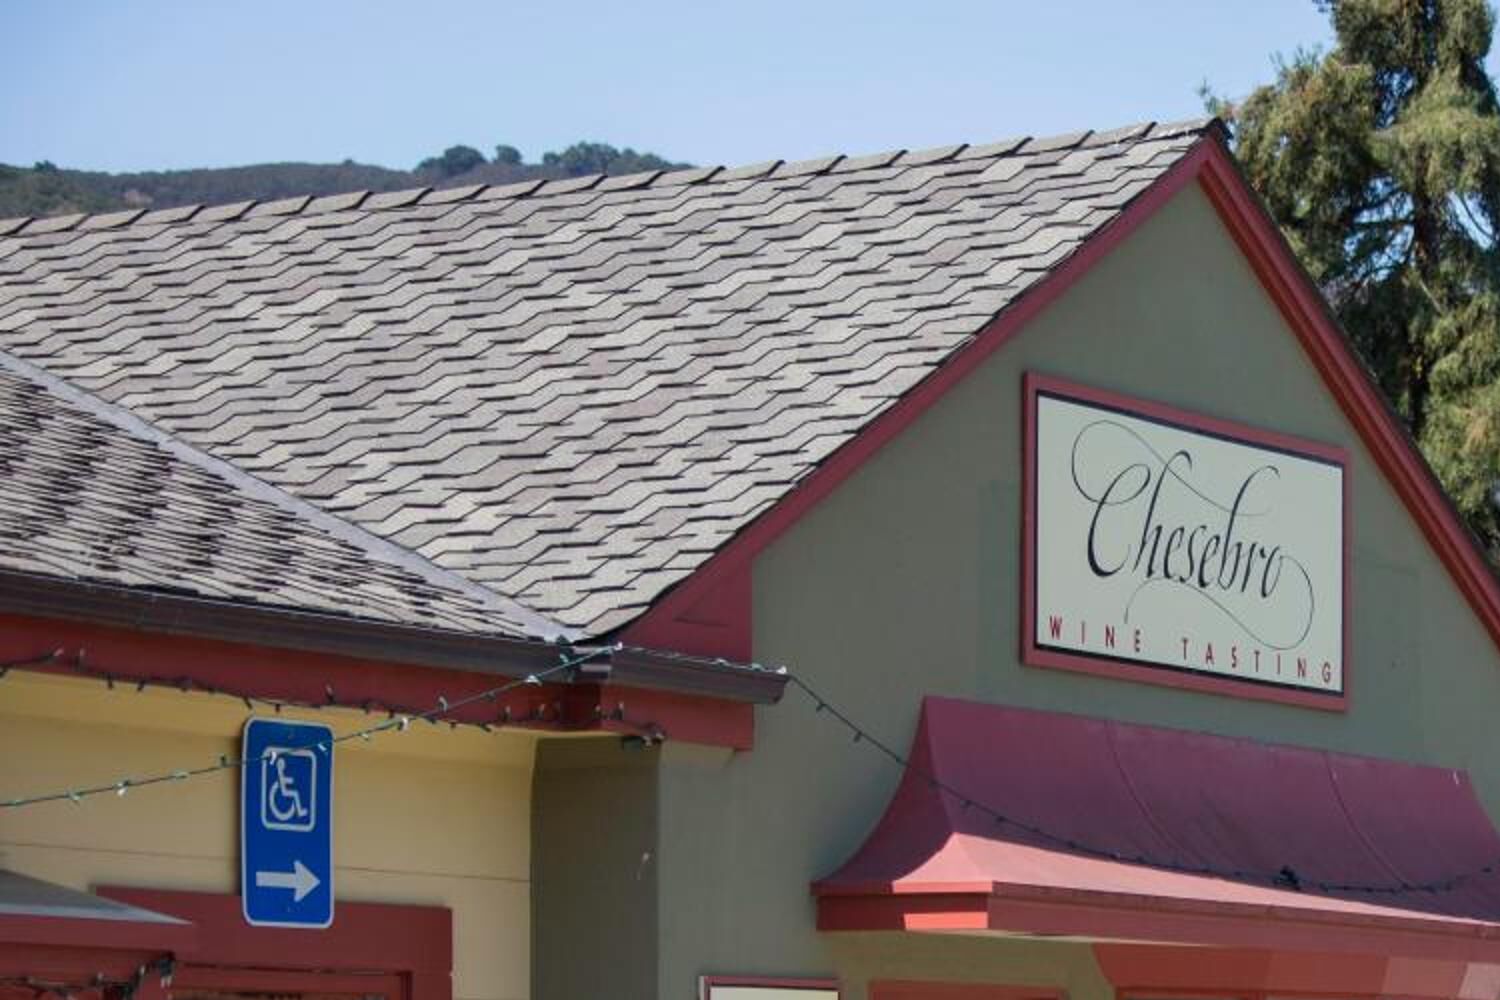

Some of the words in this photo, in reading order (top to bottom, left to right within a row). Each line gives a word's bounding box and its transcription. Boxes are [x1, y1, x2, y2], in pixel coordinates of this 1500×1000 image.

[1071, 419, 1315, 651] Chesebro
[1048, 615, 1143, 654] WINE
[1181, 636, 1333, 684] TASTING
